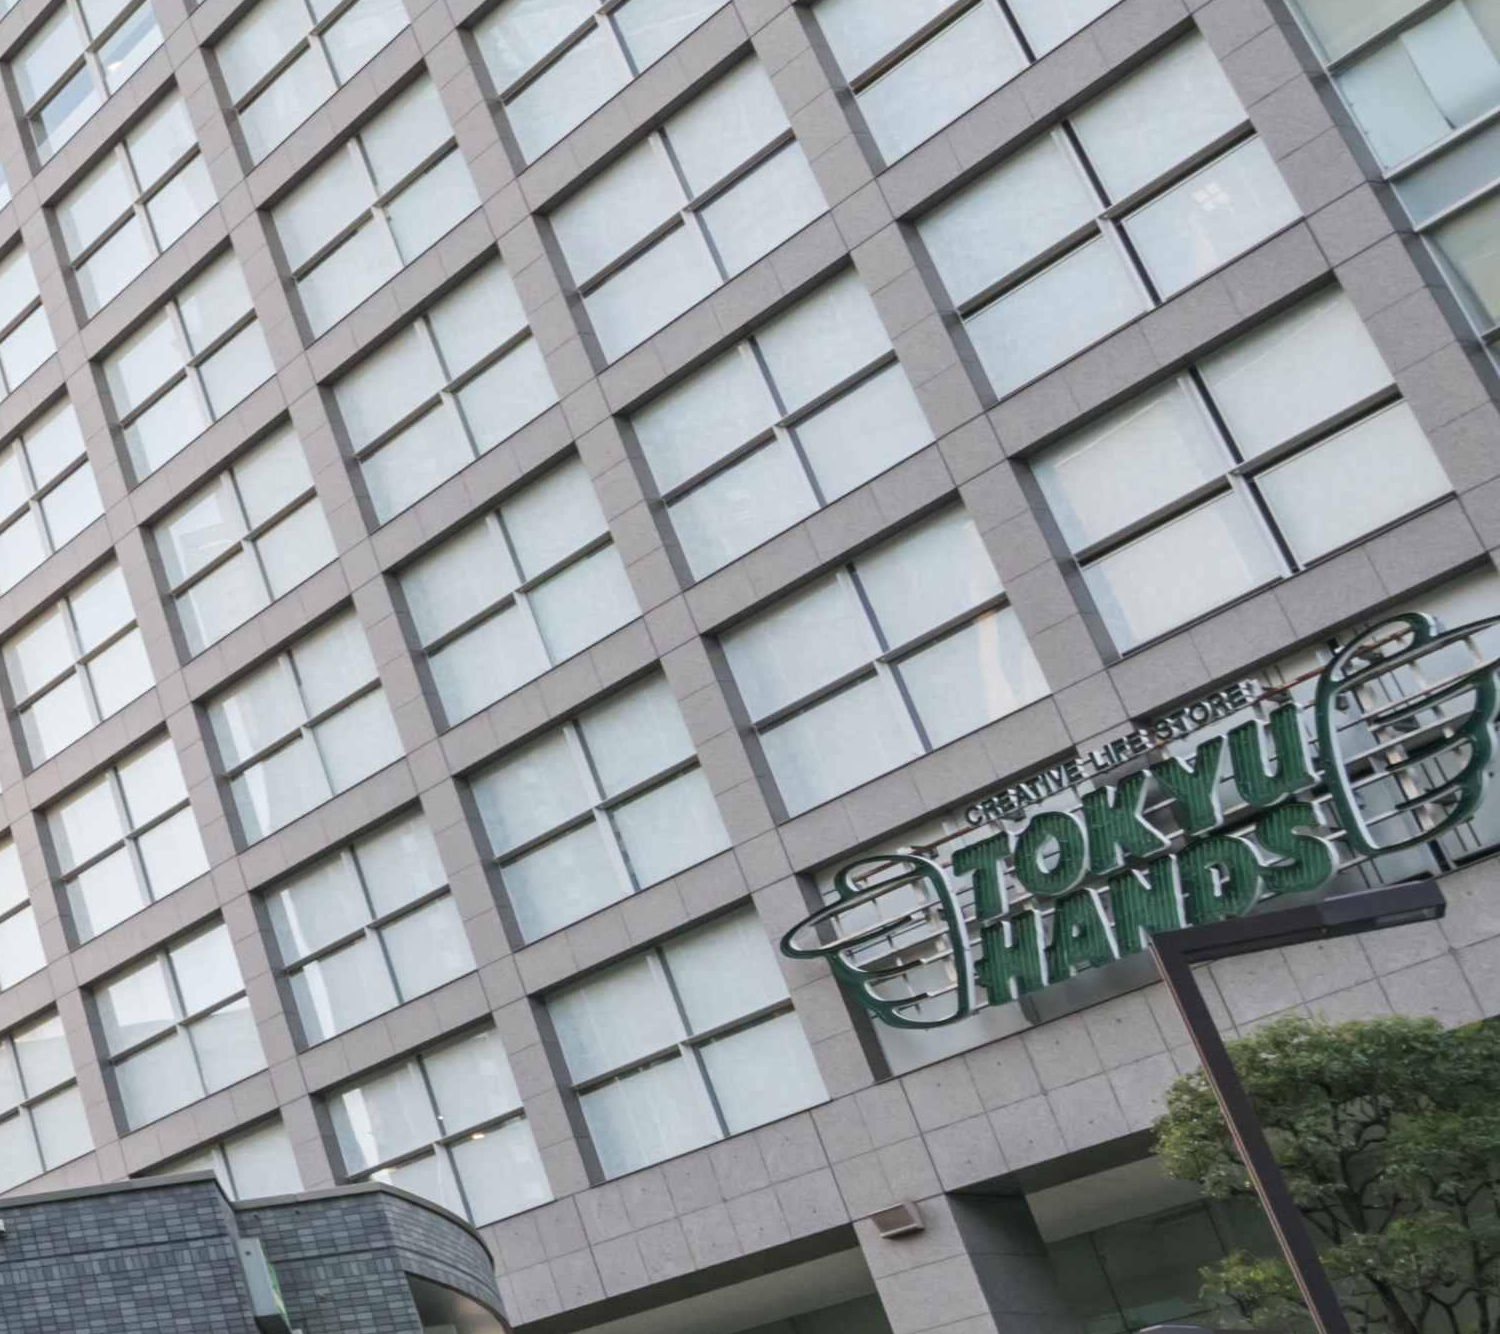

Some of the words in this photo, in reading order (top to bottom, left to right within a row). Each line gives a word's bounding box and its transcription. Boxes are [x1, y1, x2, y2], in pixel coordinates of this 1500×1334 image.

[952, 703, 1318, 921] TOKYU
[964, 757, 1086, 827] CREATIVE
[1088, 728, 1152, 771] LIFE
[1153, 679, 1258, 741] STORE
[977, 801, 1340, 1007] HANDS
